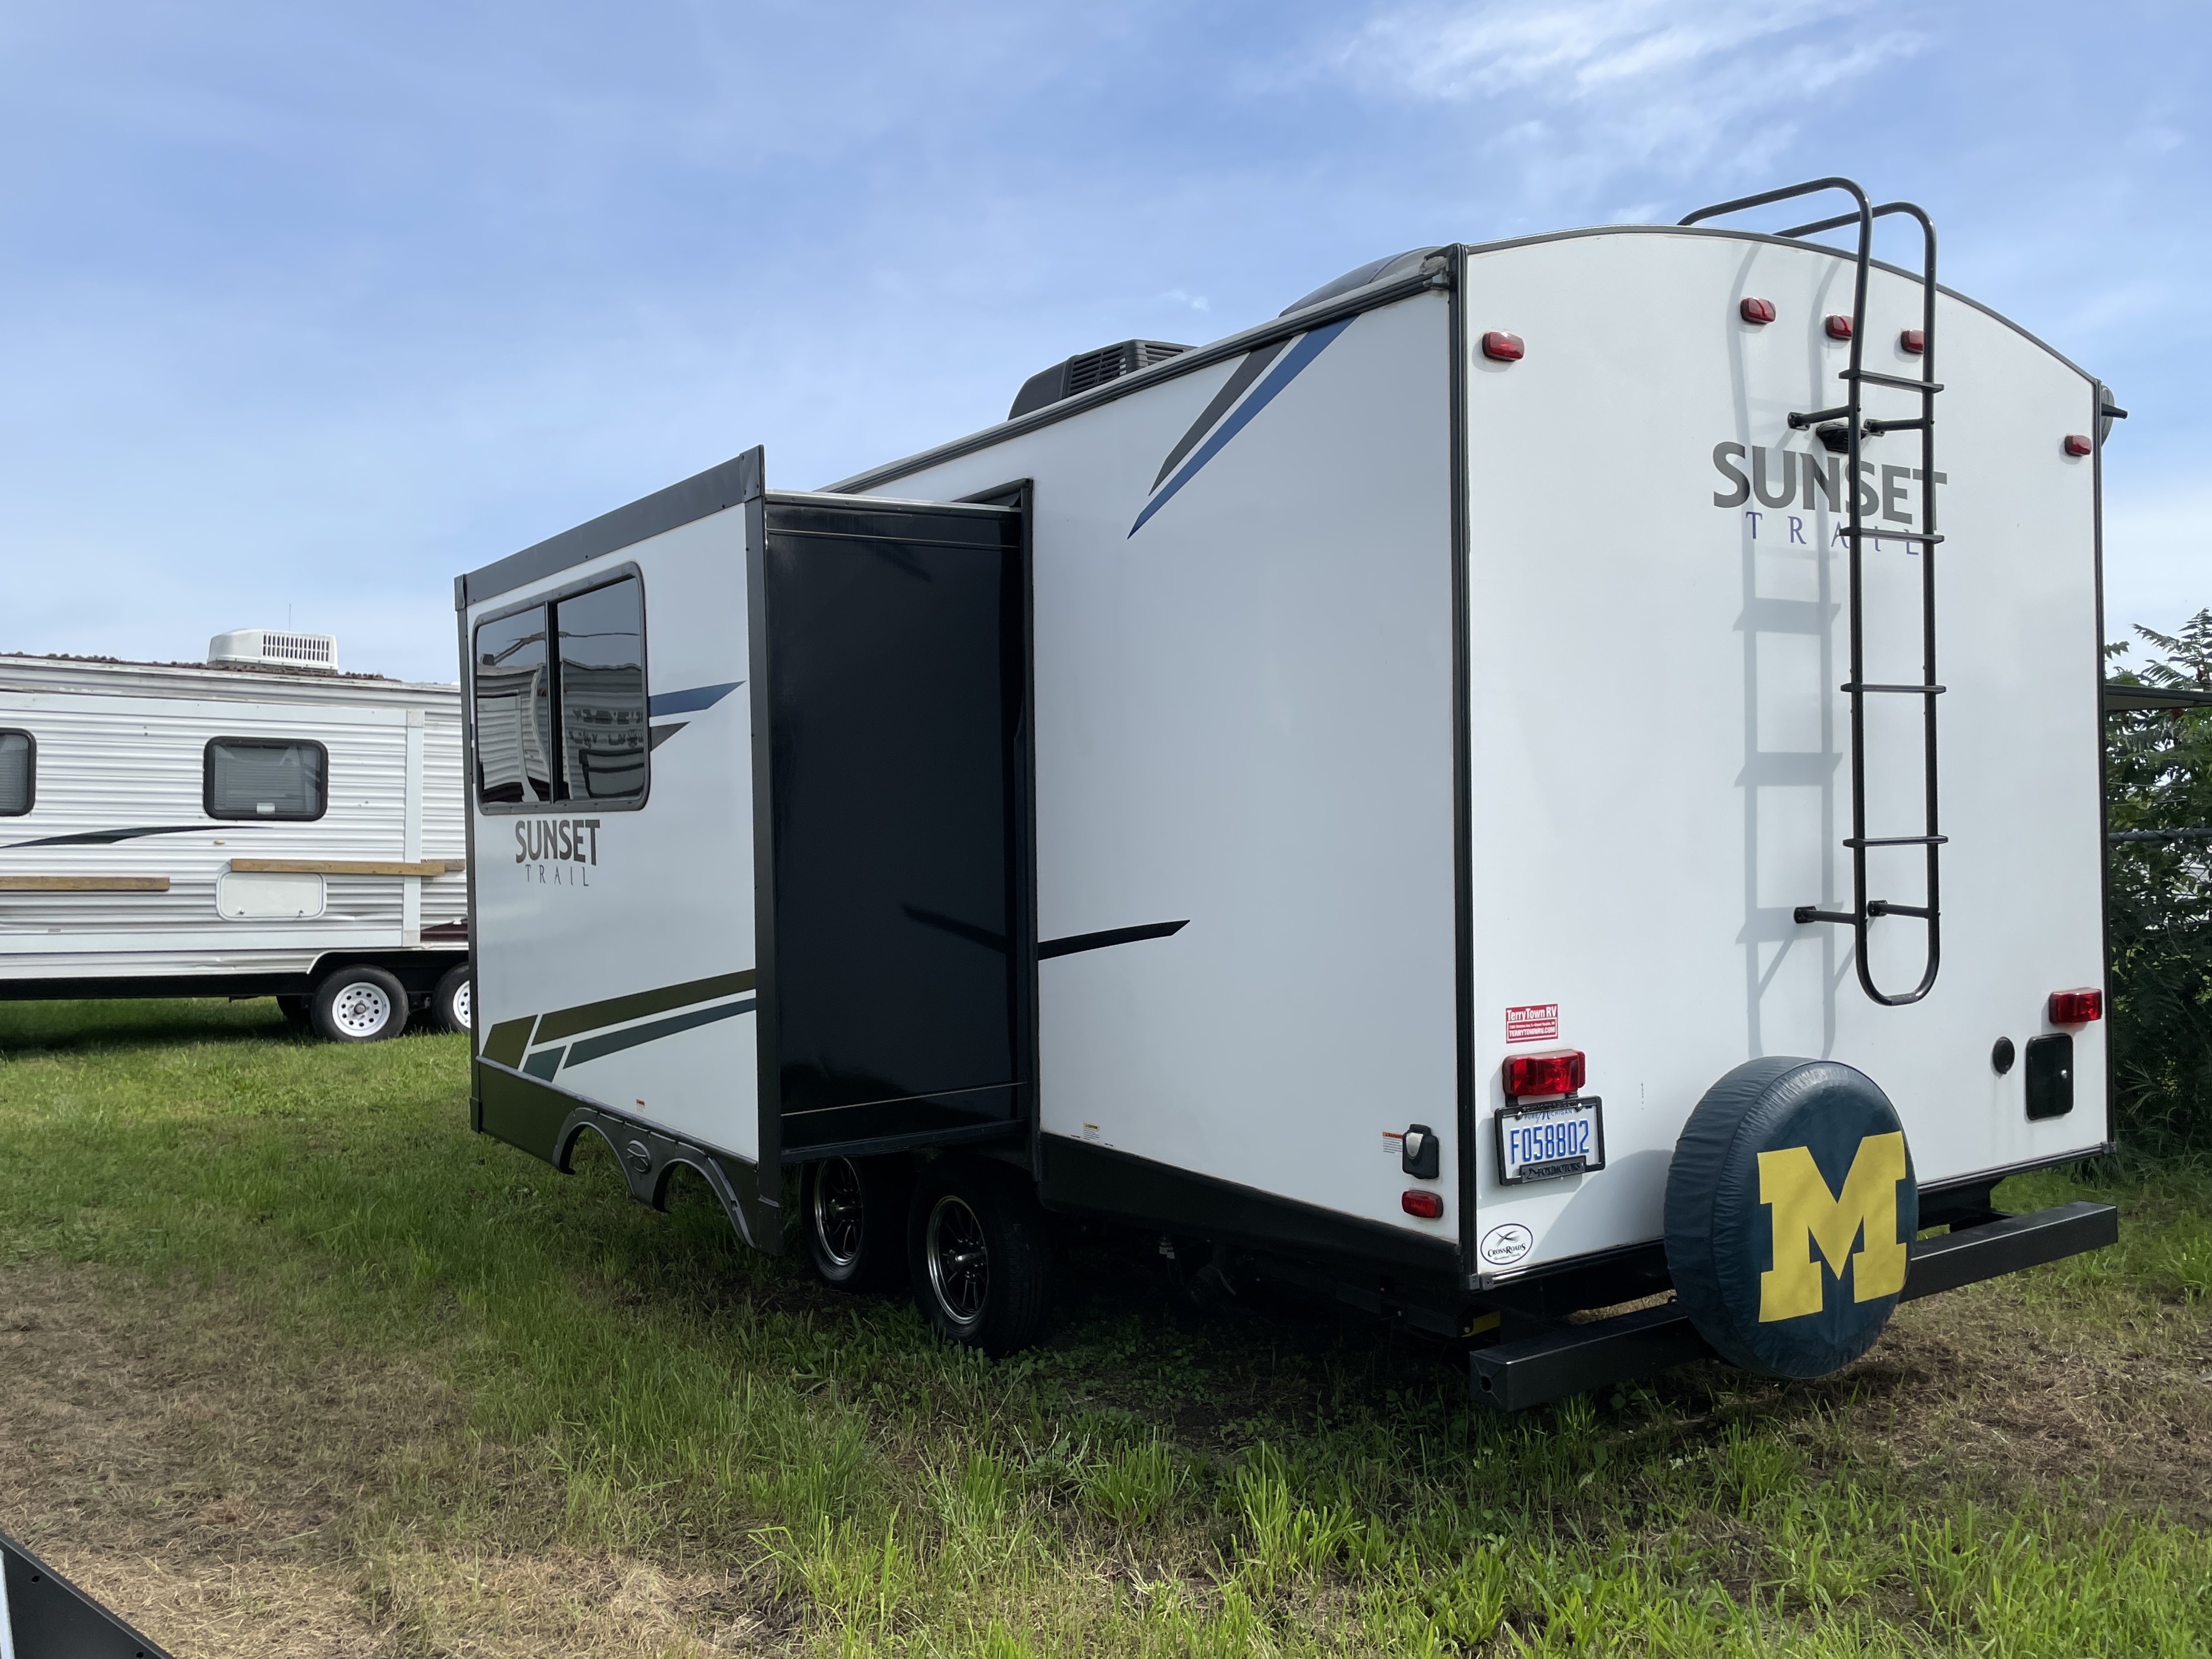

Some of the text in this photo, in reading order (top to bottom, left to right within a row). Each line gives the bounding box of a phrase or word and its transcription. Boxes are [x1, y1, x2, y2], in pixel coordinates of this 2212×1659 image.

[515, 819, 600, 866] SUNSET
[526, 863, 589, 886] TRAIL
[1546, 1006, 1557, 1017] RV
[1510, 1119, 1589, 1165] F058802
[1757, 1130, 1907, 1323] M
